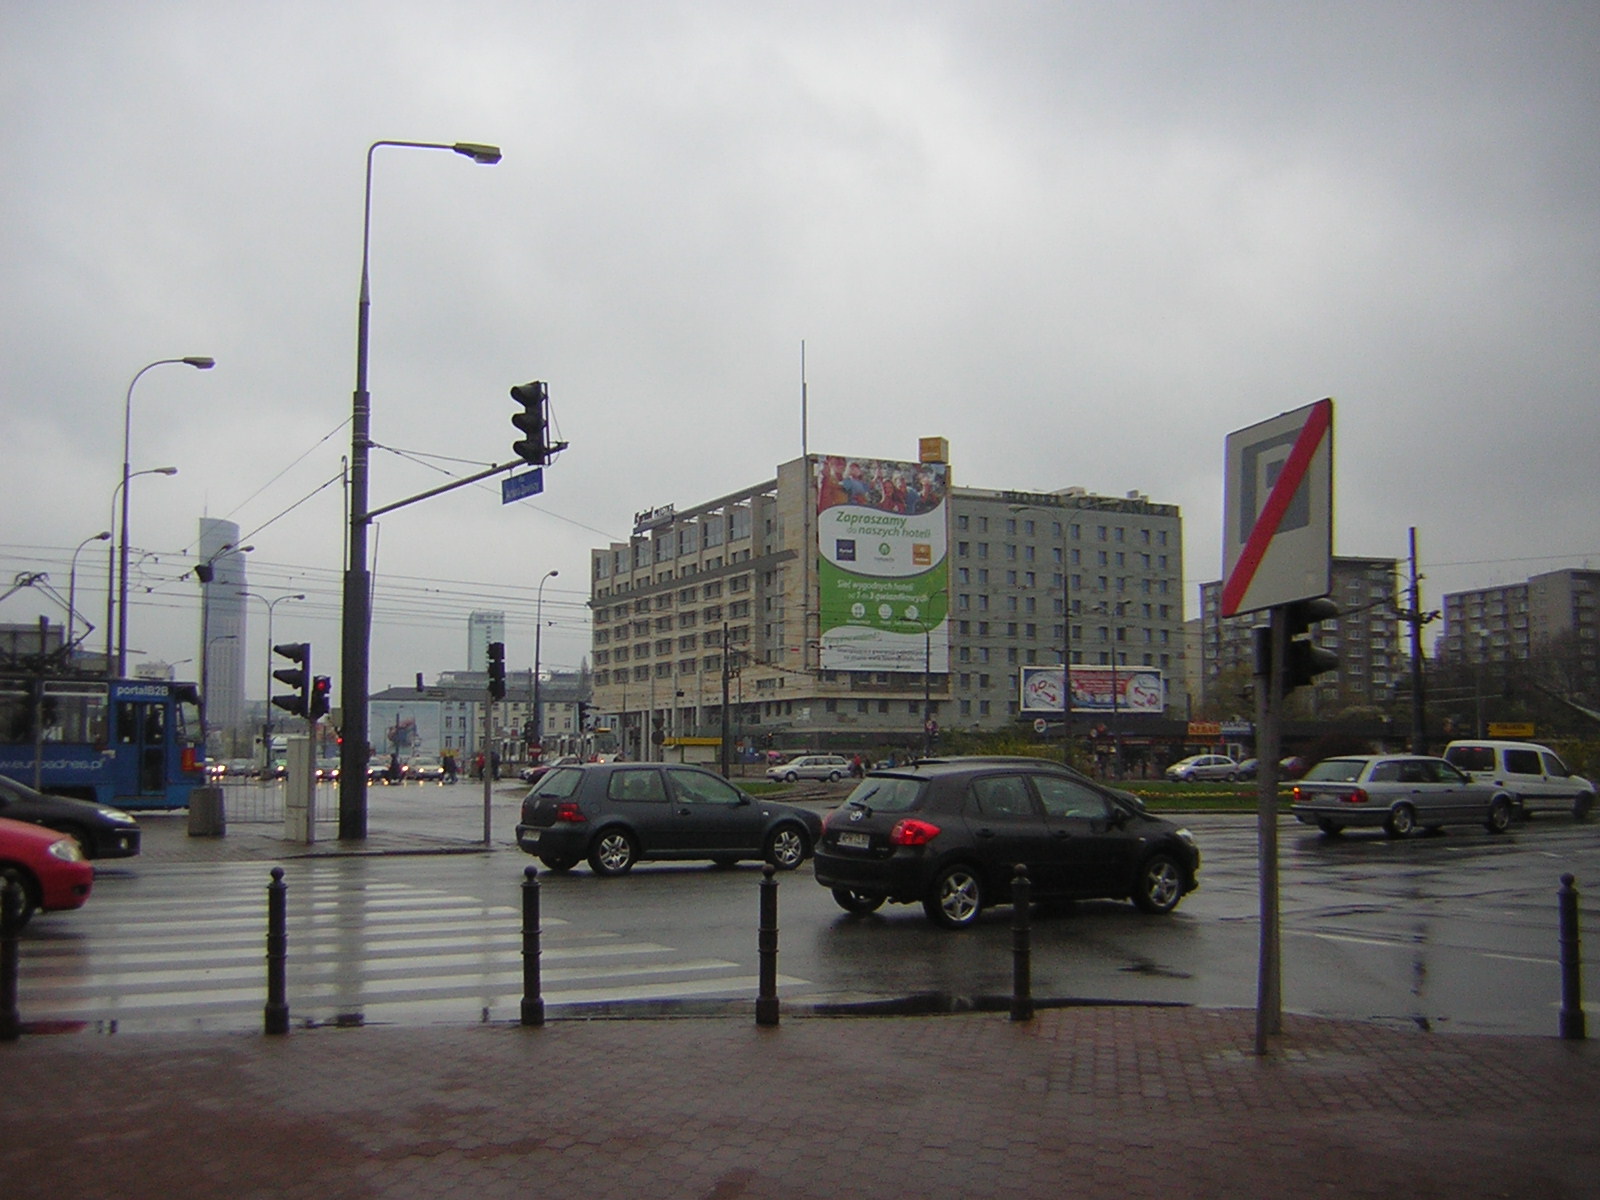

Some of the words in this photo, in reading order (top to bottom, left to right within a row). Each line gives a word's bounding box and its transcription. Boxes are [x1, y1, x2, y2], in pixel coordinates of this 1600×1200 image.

[836, 510, 908, 529] Zapraszamy
[858, 525, 900, 538] naszych
[117, 685, 169, 697] portalB2B
